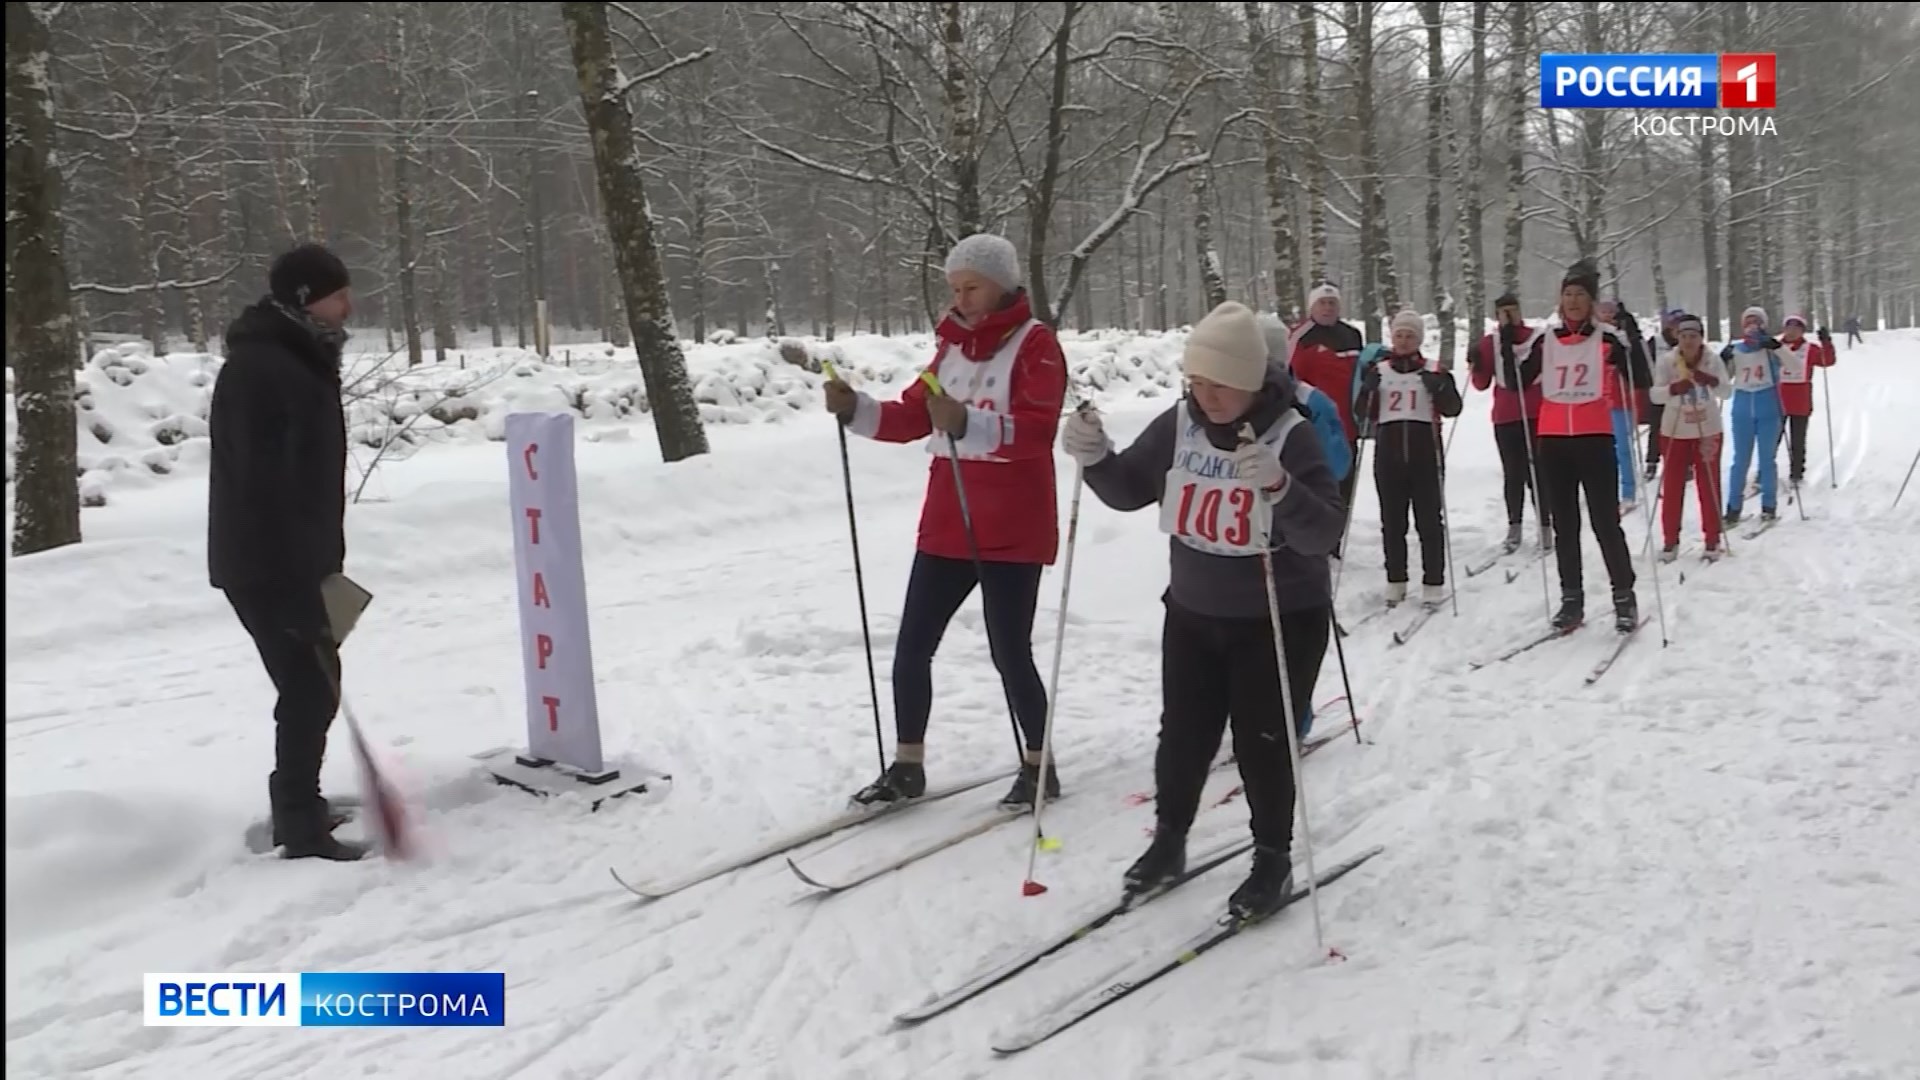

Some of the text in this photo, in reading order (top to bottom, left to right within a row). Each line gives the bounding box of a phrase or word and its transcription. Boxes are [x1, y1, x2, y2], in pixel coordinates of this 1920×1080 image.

[1555, 363, 1589, 389] 72
[1742, 364, 1765, 383] 74
[1388, 390, 1418, 412] 21
[1177, 482, 1254, 547] 103
[524, 443, 561, 732] СТАРТ
